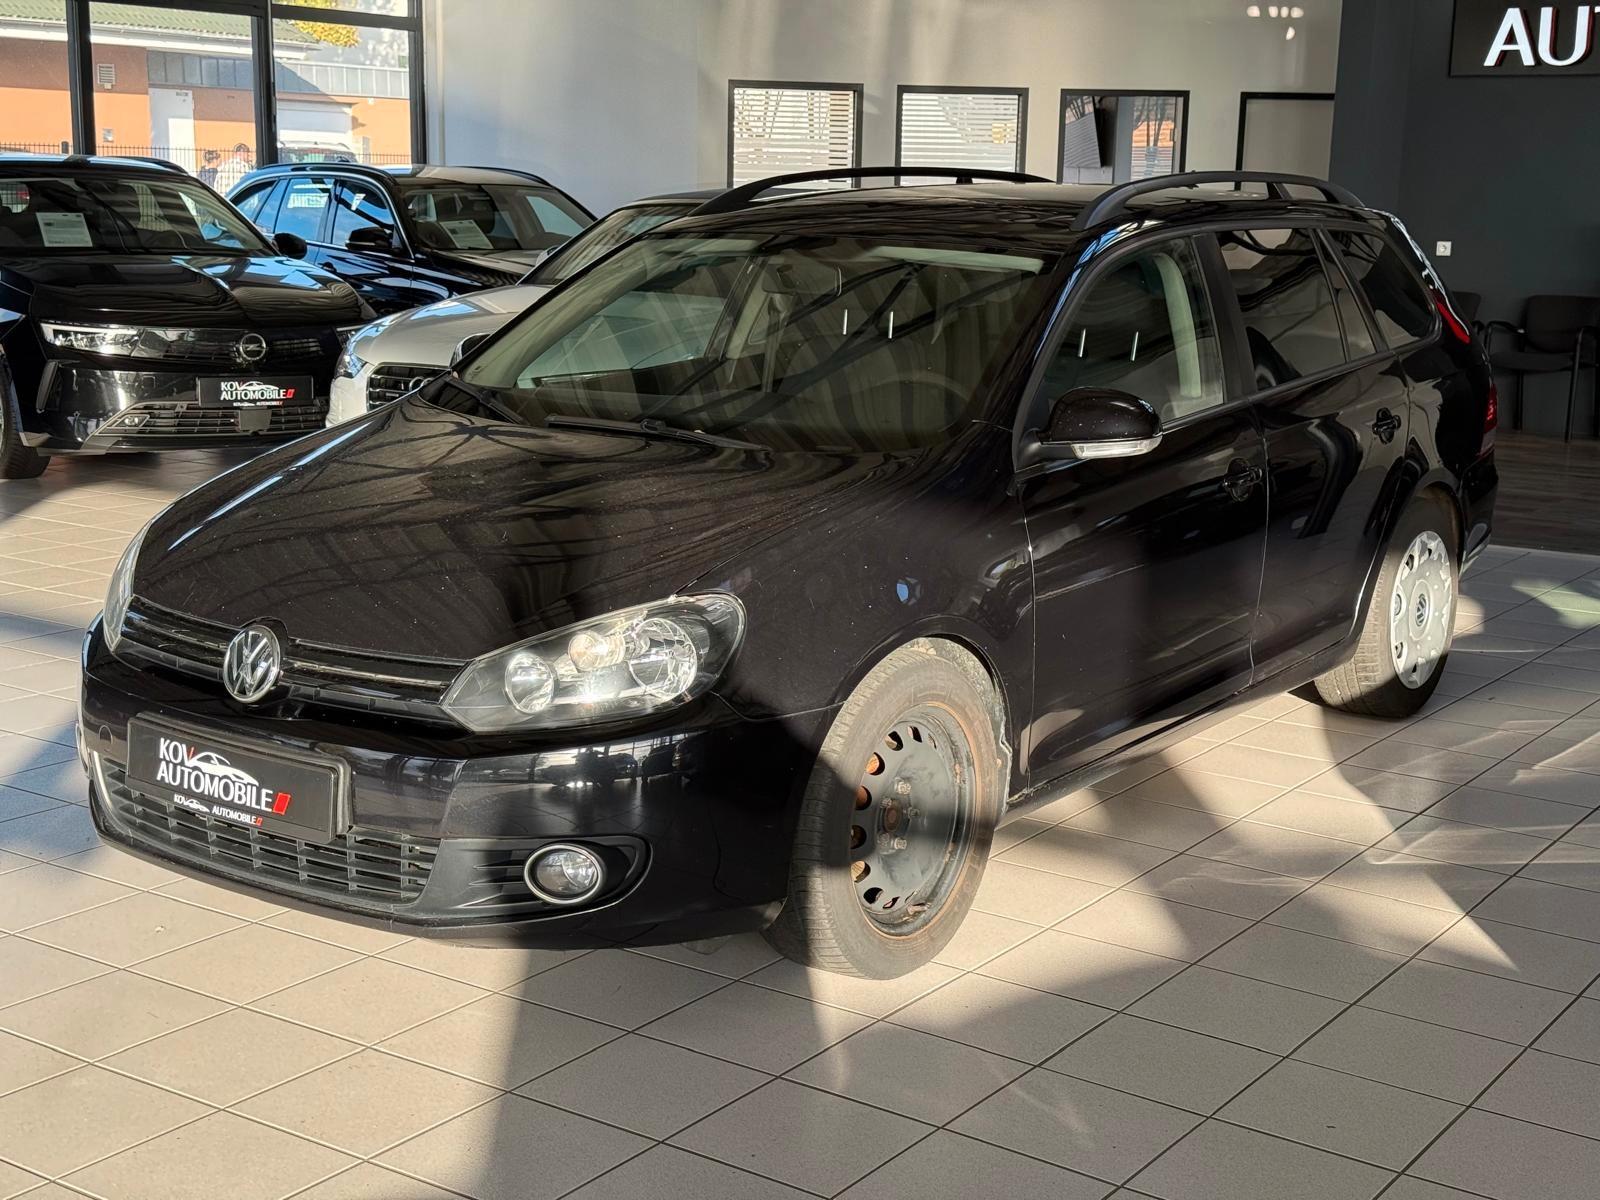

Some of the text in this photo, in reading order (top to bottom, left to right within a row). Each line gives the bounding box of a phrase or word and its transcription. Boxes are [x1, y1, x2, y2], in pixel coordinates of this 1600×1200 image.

[1483, 5, 1600, 67] AU
[220, 389, 287, 400] AUTOMOBILE
[221, 381, 243, 391] KOV
[160, 738, 194, 768] KOV
[157, 761, 273, 812] AUTOMOBILE
[174, 794, 256, 825] KOV AUTOMOBILE
